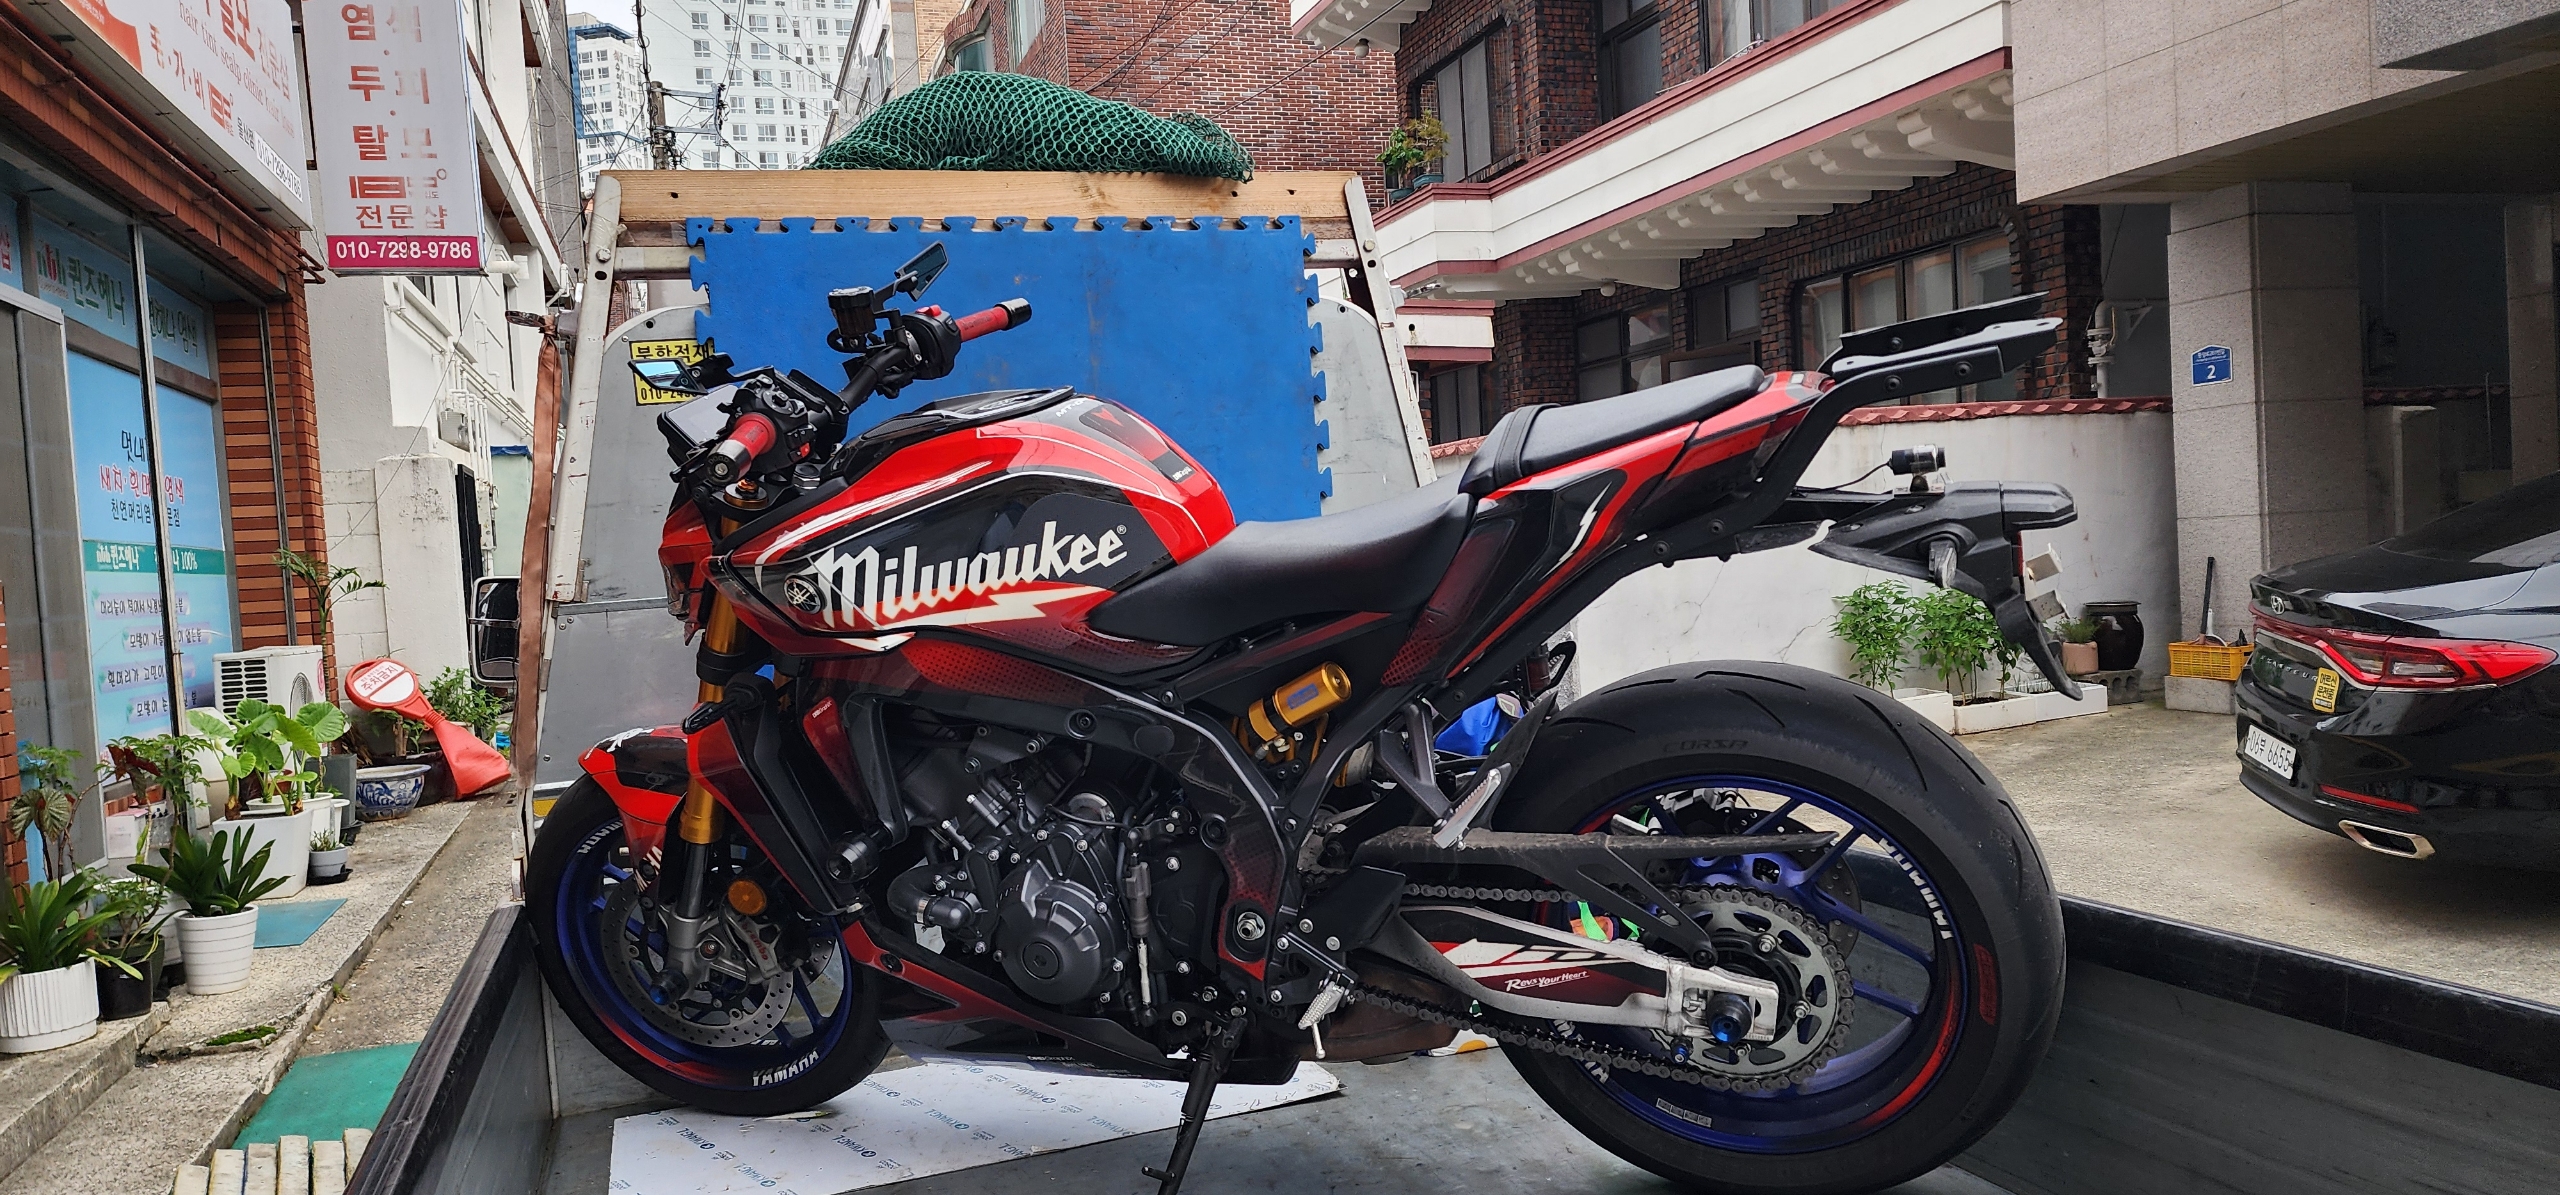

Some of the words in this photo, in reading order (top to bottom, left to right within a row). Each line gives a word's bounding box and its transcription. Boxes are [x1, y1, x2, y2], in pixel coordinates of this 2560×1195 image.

[336, 241, 472, 259] 010-7298-9786
[67, 256, 127, 327] 퀸즈헤나
[2206, 364, 2217, 380] 2
[164, 475, 185, 504] 염색
[797, 520, 1129, 629] Milwaukee
[130, 633, 150, 648] 모발이
[360, 665, 399, 691] 주차금지
[136, 699, 158, 717] 모발이
[2267, 740, 2291, 772] 6655
[1504, 978, 1538, 992] Revs
[1538, 976, 1561, 988] Your
[1561, 970, 1586, 981] Heart
[752, 1050, 820, 1087] YAMAHA
